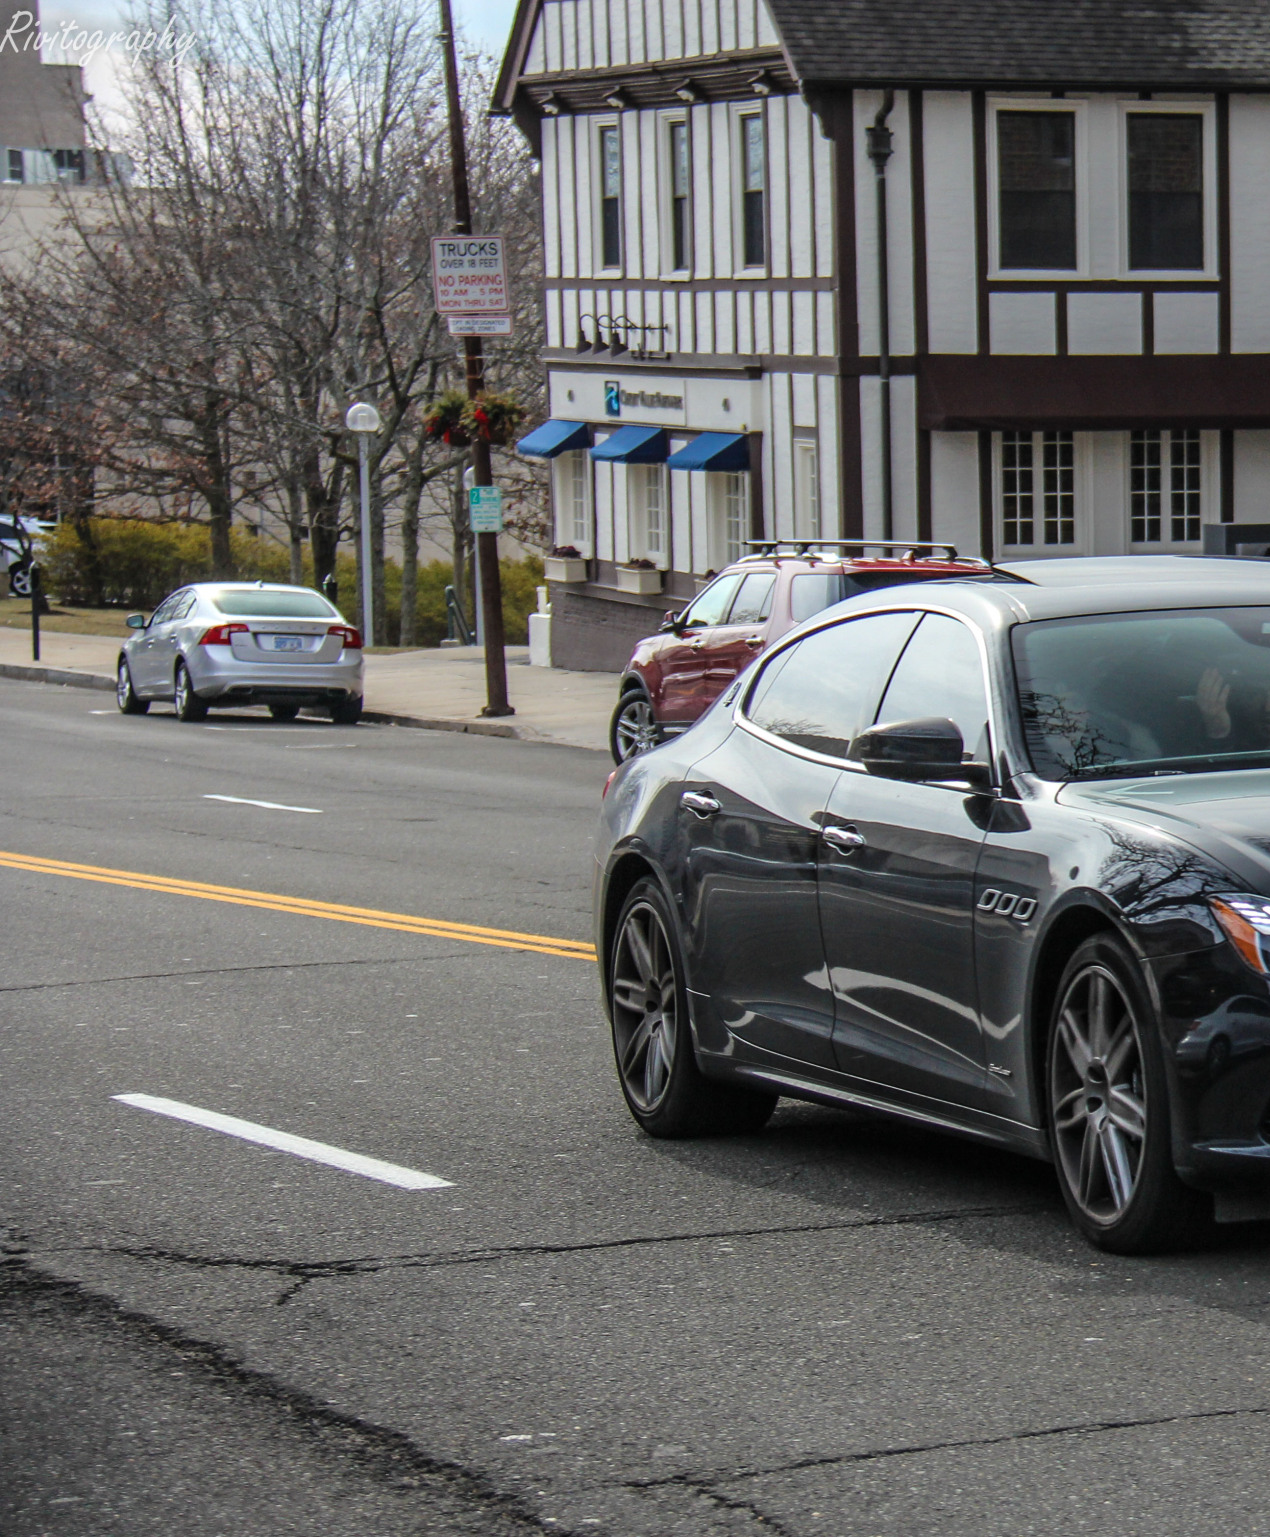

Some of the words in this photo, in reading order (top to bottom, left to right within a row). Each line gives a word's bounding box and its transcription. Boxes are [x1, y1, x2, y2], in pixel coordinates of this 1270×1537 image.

[439, 242, 498, 257] TRUCKS
[440, 259, 464, 269] OVER
[467, 259, 477, 269] 18
[479, 258, 498, 268] FEET
[438, 275, 455, 287] NO
[458, 274, 502, 286] PARKING
[440, 289, 449, 297] 10
[453, 288, 468, 296] AM
[479, 287, 485, 296] 5
[489, 287, 503, 295] PM
[440, 300, 461, 308] MON
[464, 299, 486, 307] THRU
